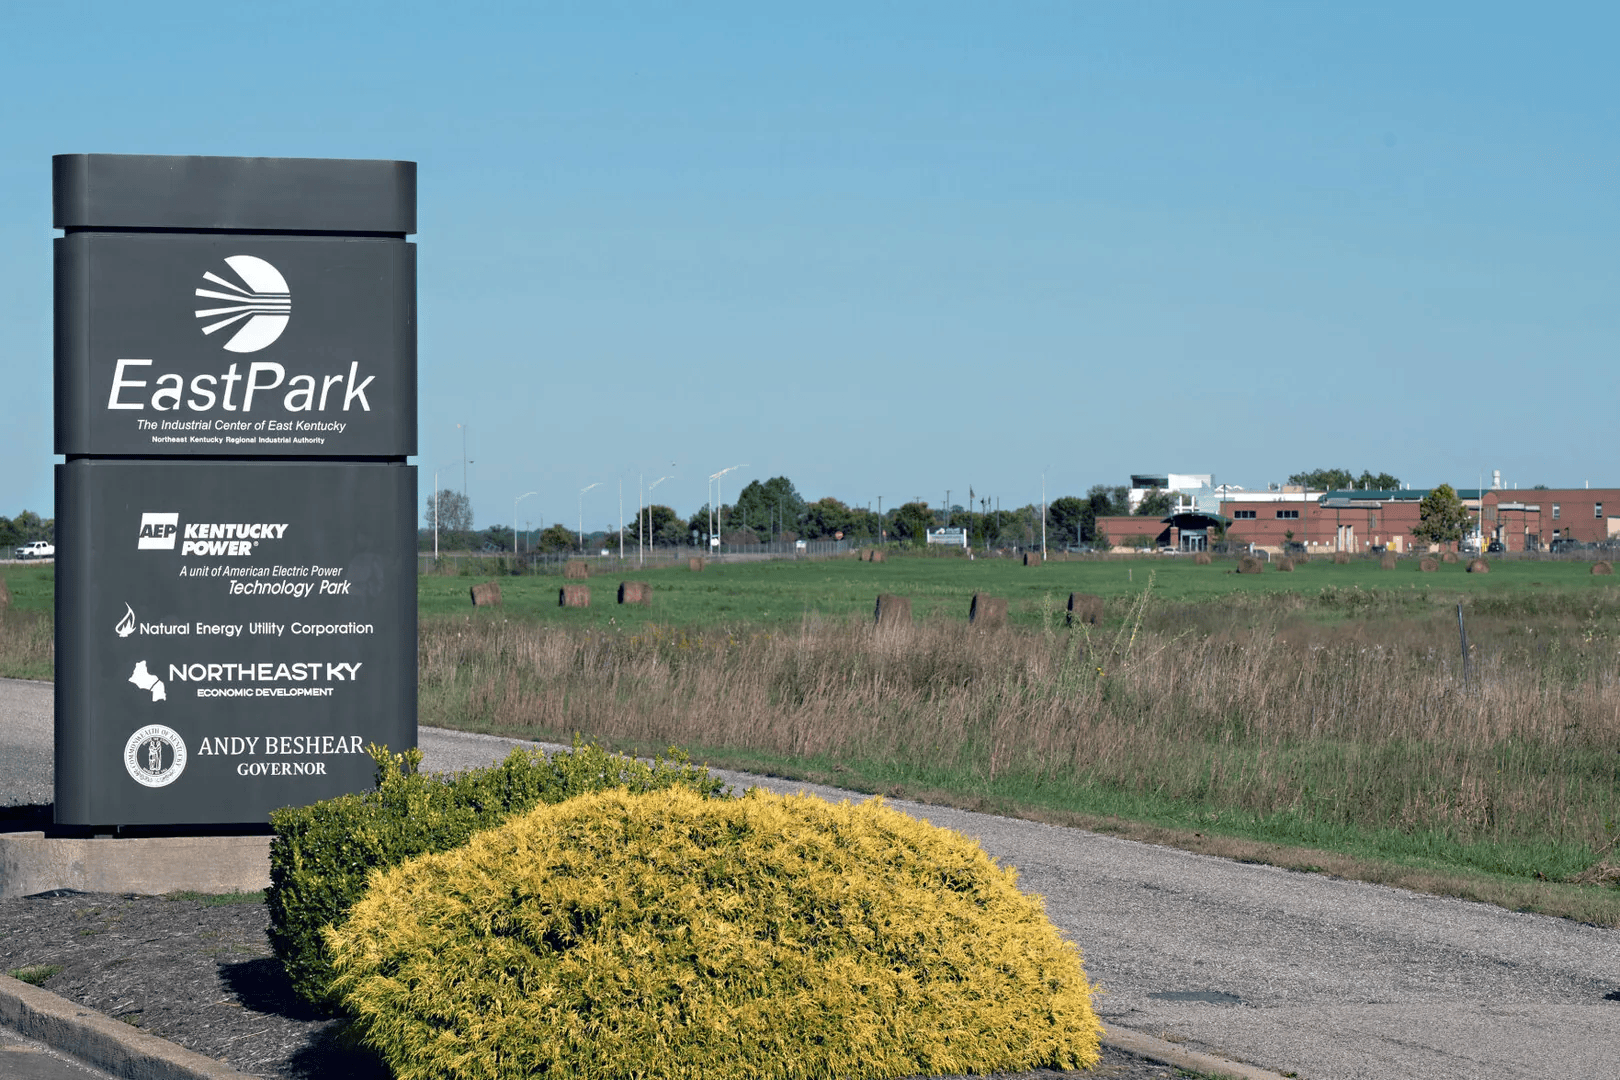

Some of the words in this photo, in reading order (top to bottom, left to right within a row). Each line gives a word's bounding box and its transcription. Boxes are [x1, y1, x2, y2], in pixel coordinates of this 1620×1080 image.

[108, 359, 375, 412] EastPark
[137, 419, 158, 430] The
[161, 419, 212, 430] Industrial
[215, 420, 250, 431] Center
[254, 420, 266, 431] of
[268, 421, 293, 431] East
[295, 421, 346, 433] Kentucky
[190, 436, 223, 444] Kentucky
[226, 436, 257, 444] Regional
[293, 437, 325, 445] Authority
[139, 523, 177, 538] AEP
[184, 524, 289, 539] KENTUCKY
[179, 566, 187, 576] A
[190, 566, 209, 576] unit
[211, 566, 222, 577] of
[223, 566, 270, 576] American
[272, 566, 309, 576] Electric
[311, 566, 343, 576] Power
[229, 580, 314, 597] Technology
[319, 580, 351, 594] Park
[140, 623, 190, 634] Natural
[196, 623, 243, 637] Energy
[249, 622, 284, 637] Utility
[291, 622, 374, 636] Corporation
[169, 663, 322, 681] NORTHEAST
[327, 663, 362, 680] KY
[197, 688, 253, 697] ECONOMIC
[255, 687, 334, 697] DEVELOPMENT
[197, 736, 258, 755] ANDY
[265, 735, 364, 755] BESHEAR
[237, 762, 327, 776] GOVERNOR
